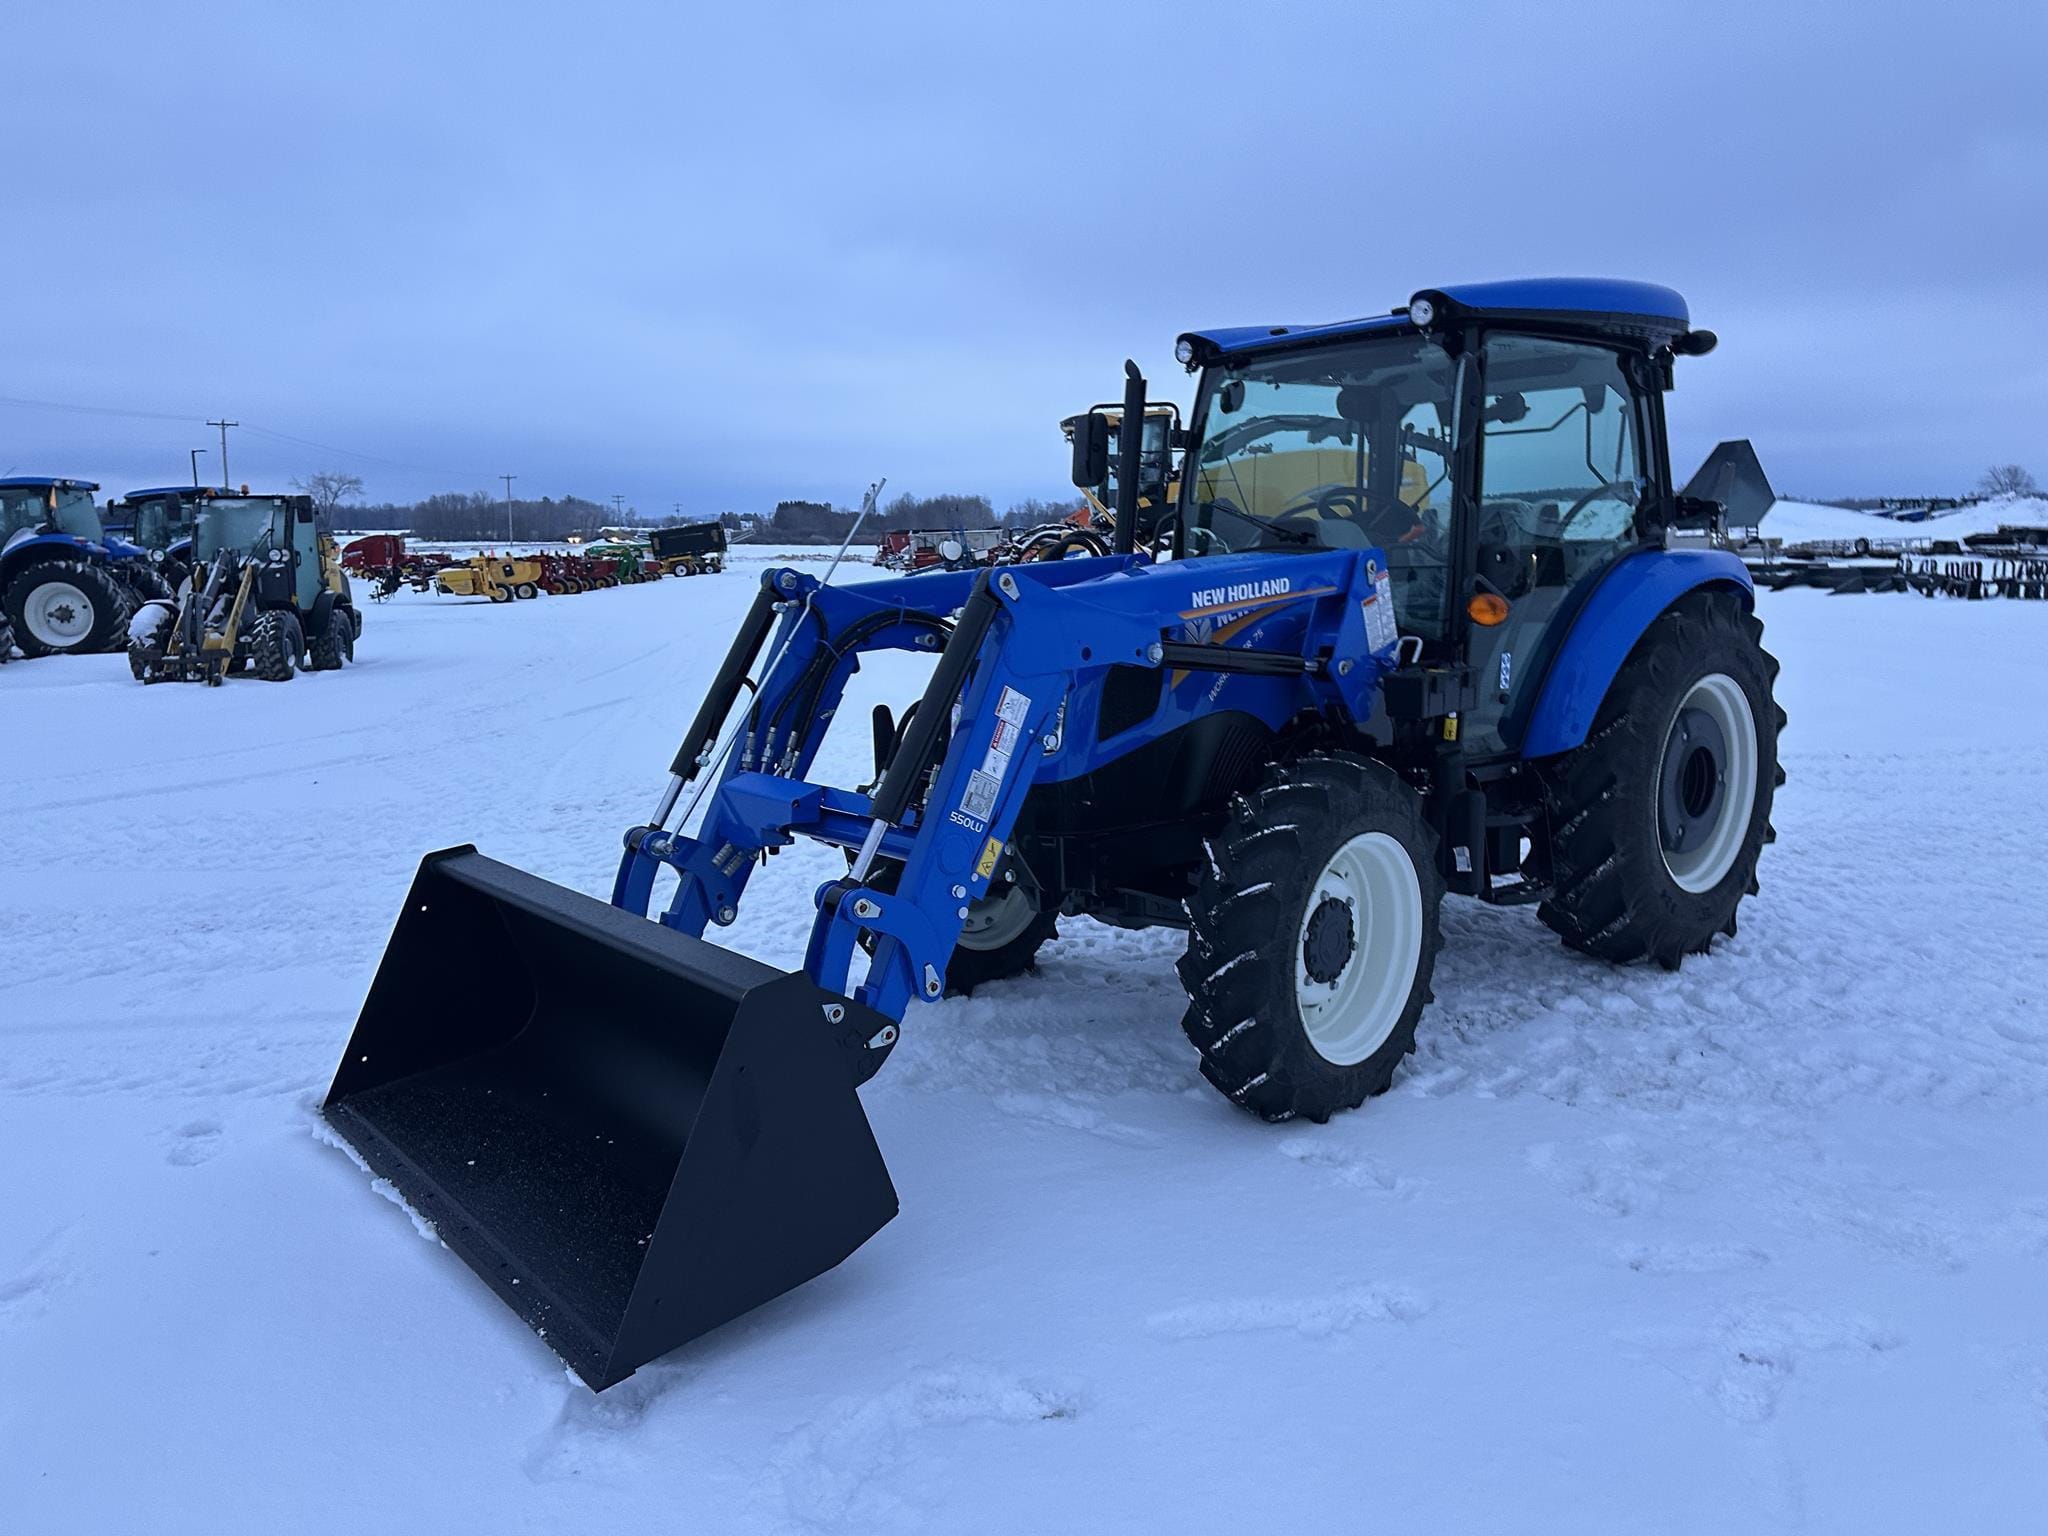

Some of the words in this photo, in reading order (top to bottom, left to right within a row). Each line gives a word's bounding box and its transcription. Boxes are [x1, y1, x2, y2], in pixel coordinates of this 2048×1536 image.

[1192, 587, 1226, 609] NEW
[1227, 577, 1290, 603] HOLLAND
[949, 811, 984, 833] 550LU
